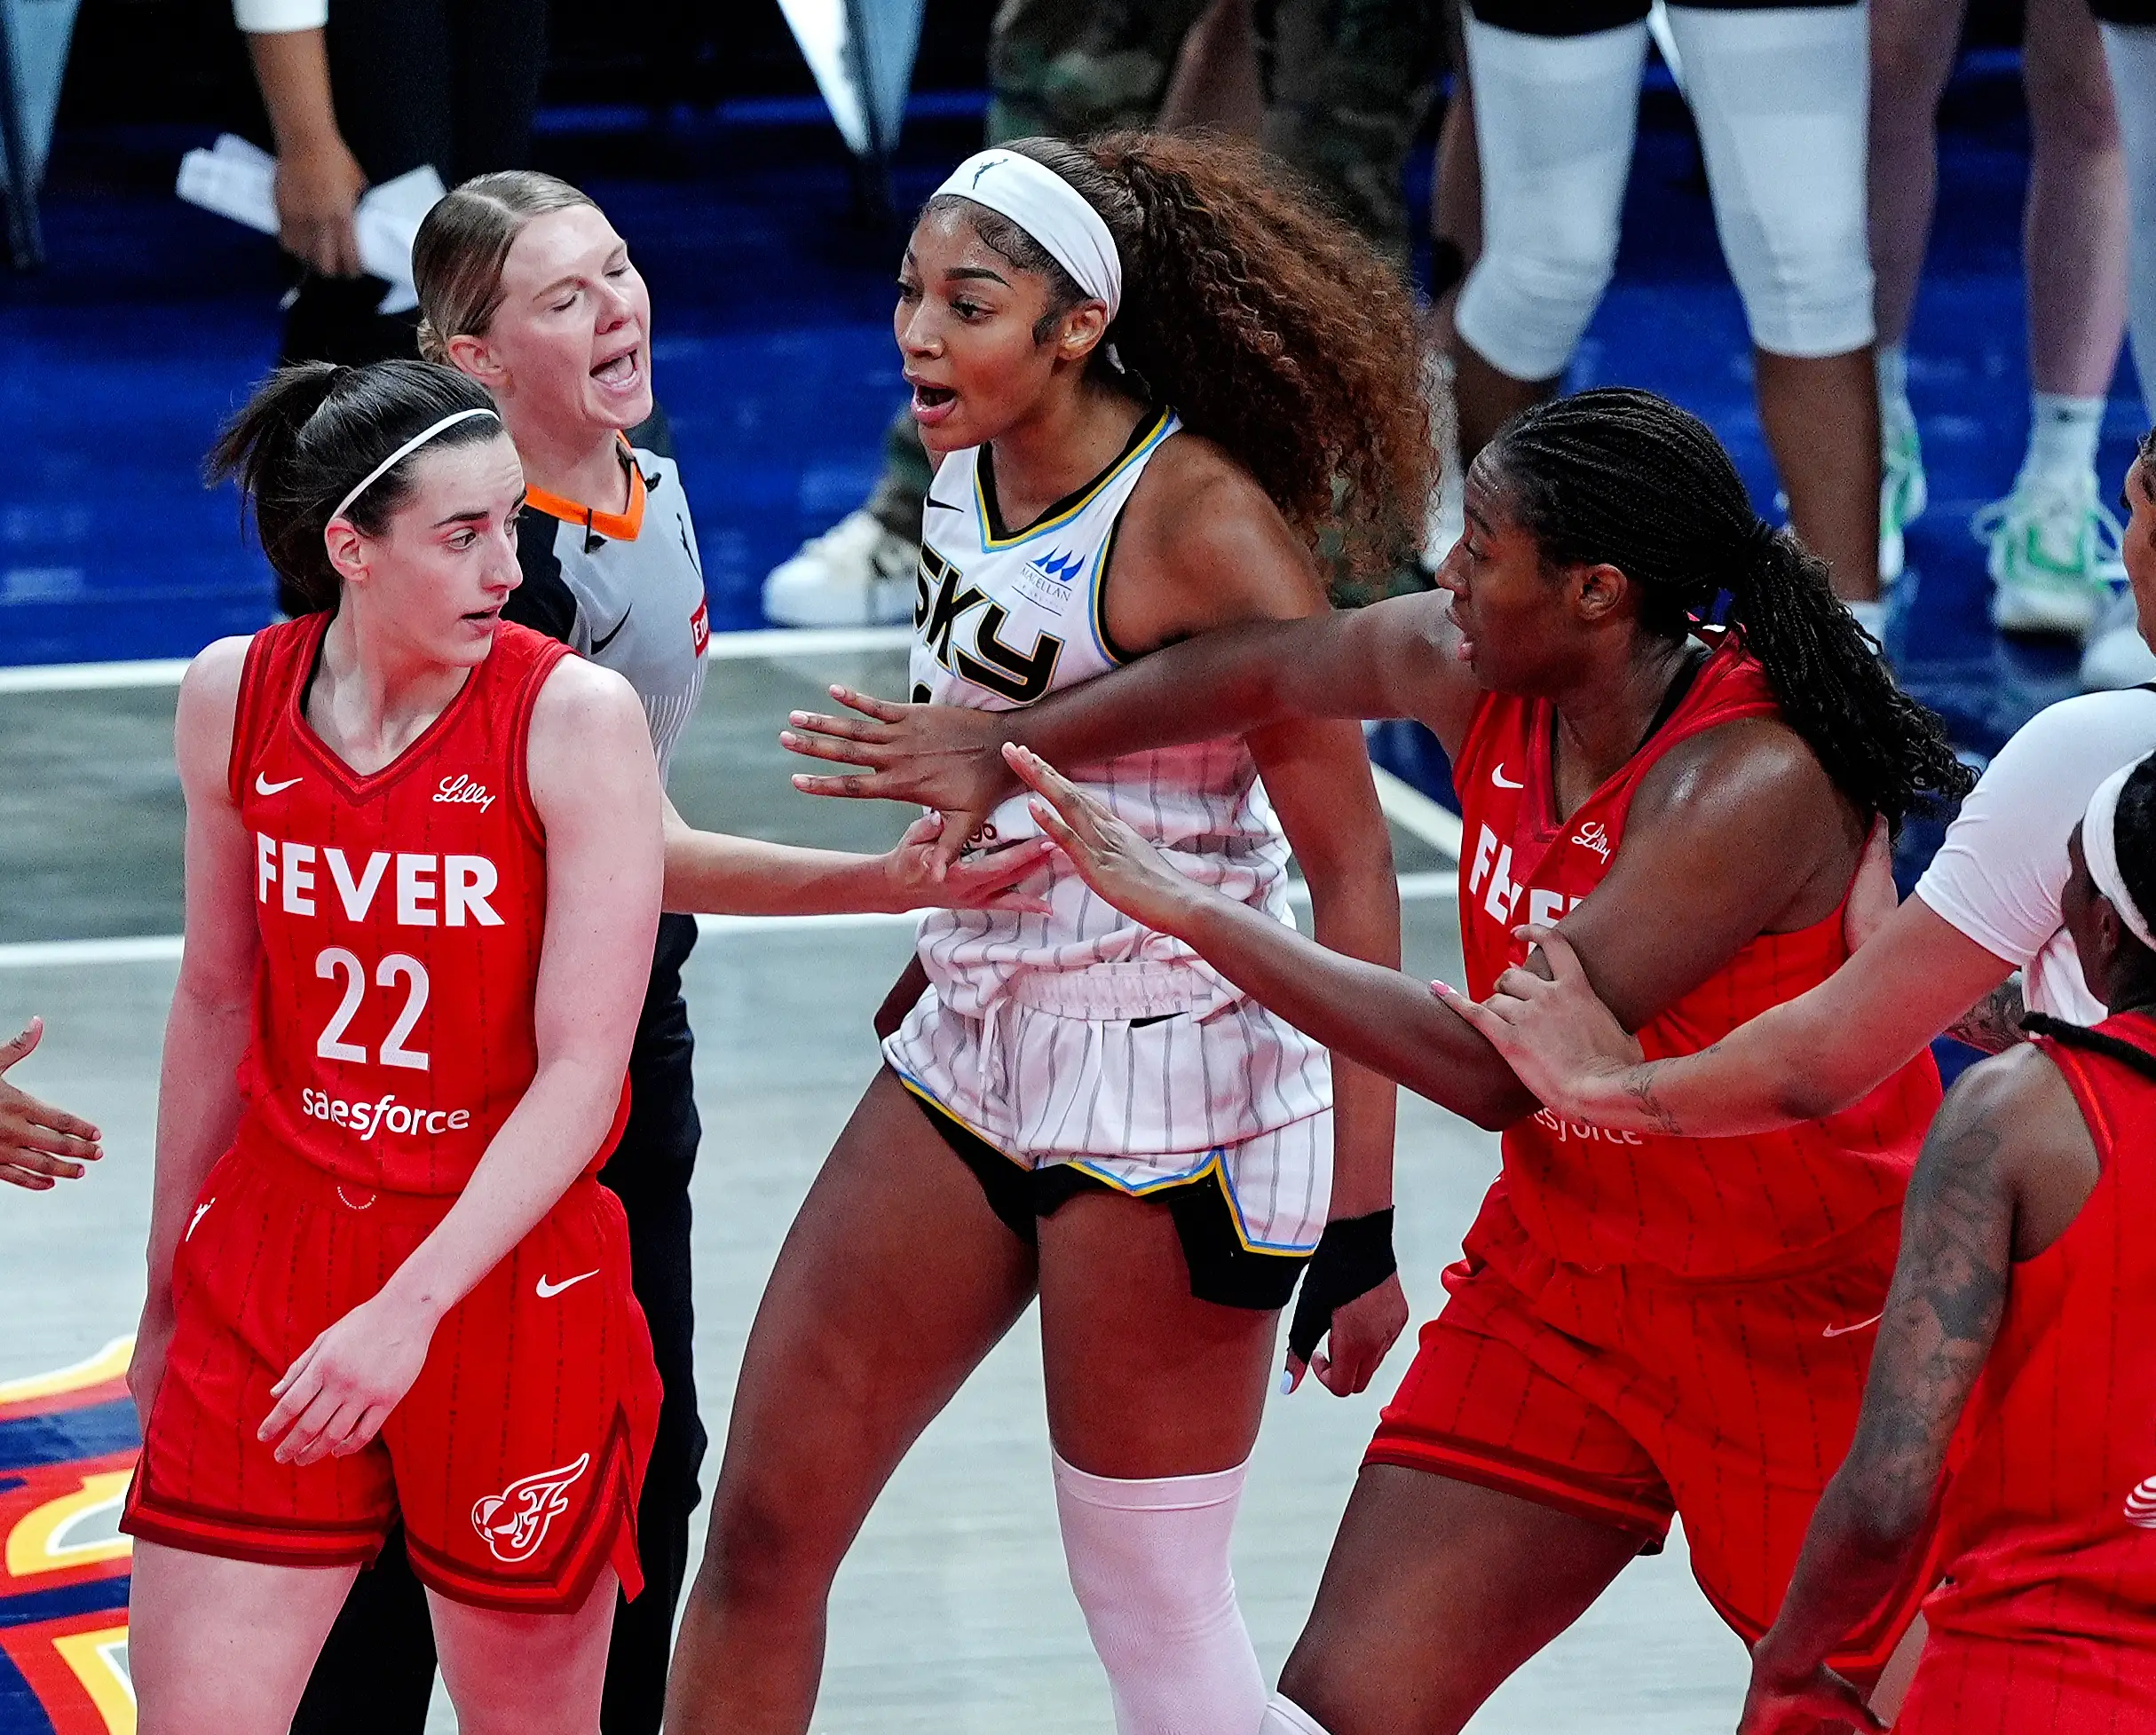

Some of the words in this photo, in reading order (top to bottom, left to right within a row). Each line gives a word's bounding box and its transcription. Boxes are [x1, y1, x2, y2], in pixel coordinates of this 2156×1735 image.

[1019, 566, 1071, 602] MAGELLAN
[432, 773, 495, 813] Lilly
[257, 831, 506, 927] FEVER
[314, 945, 430, 1071] 22
